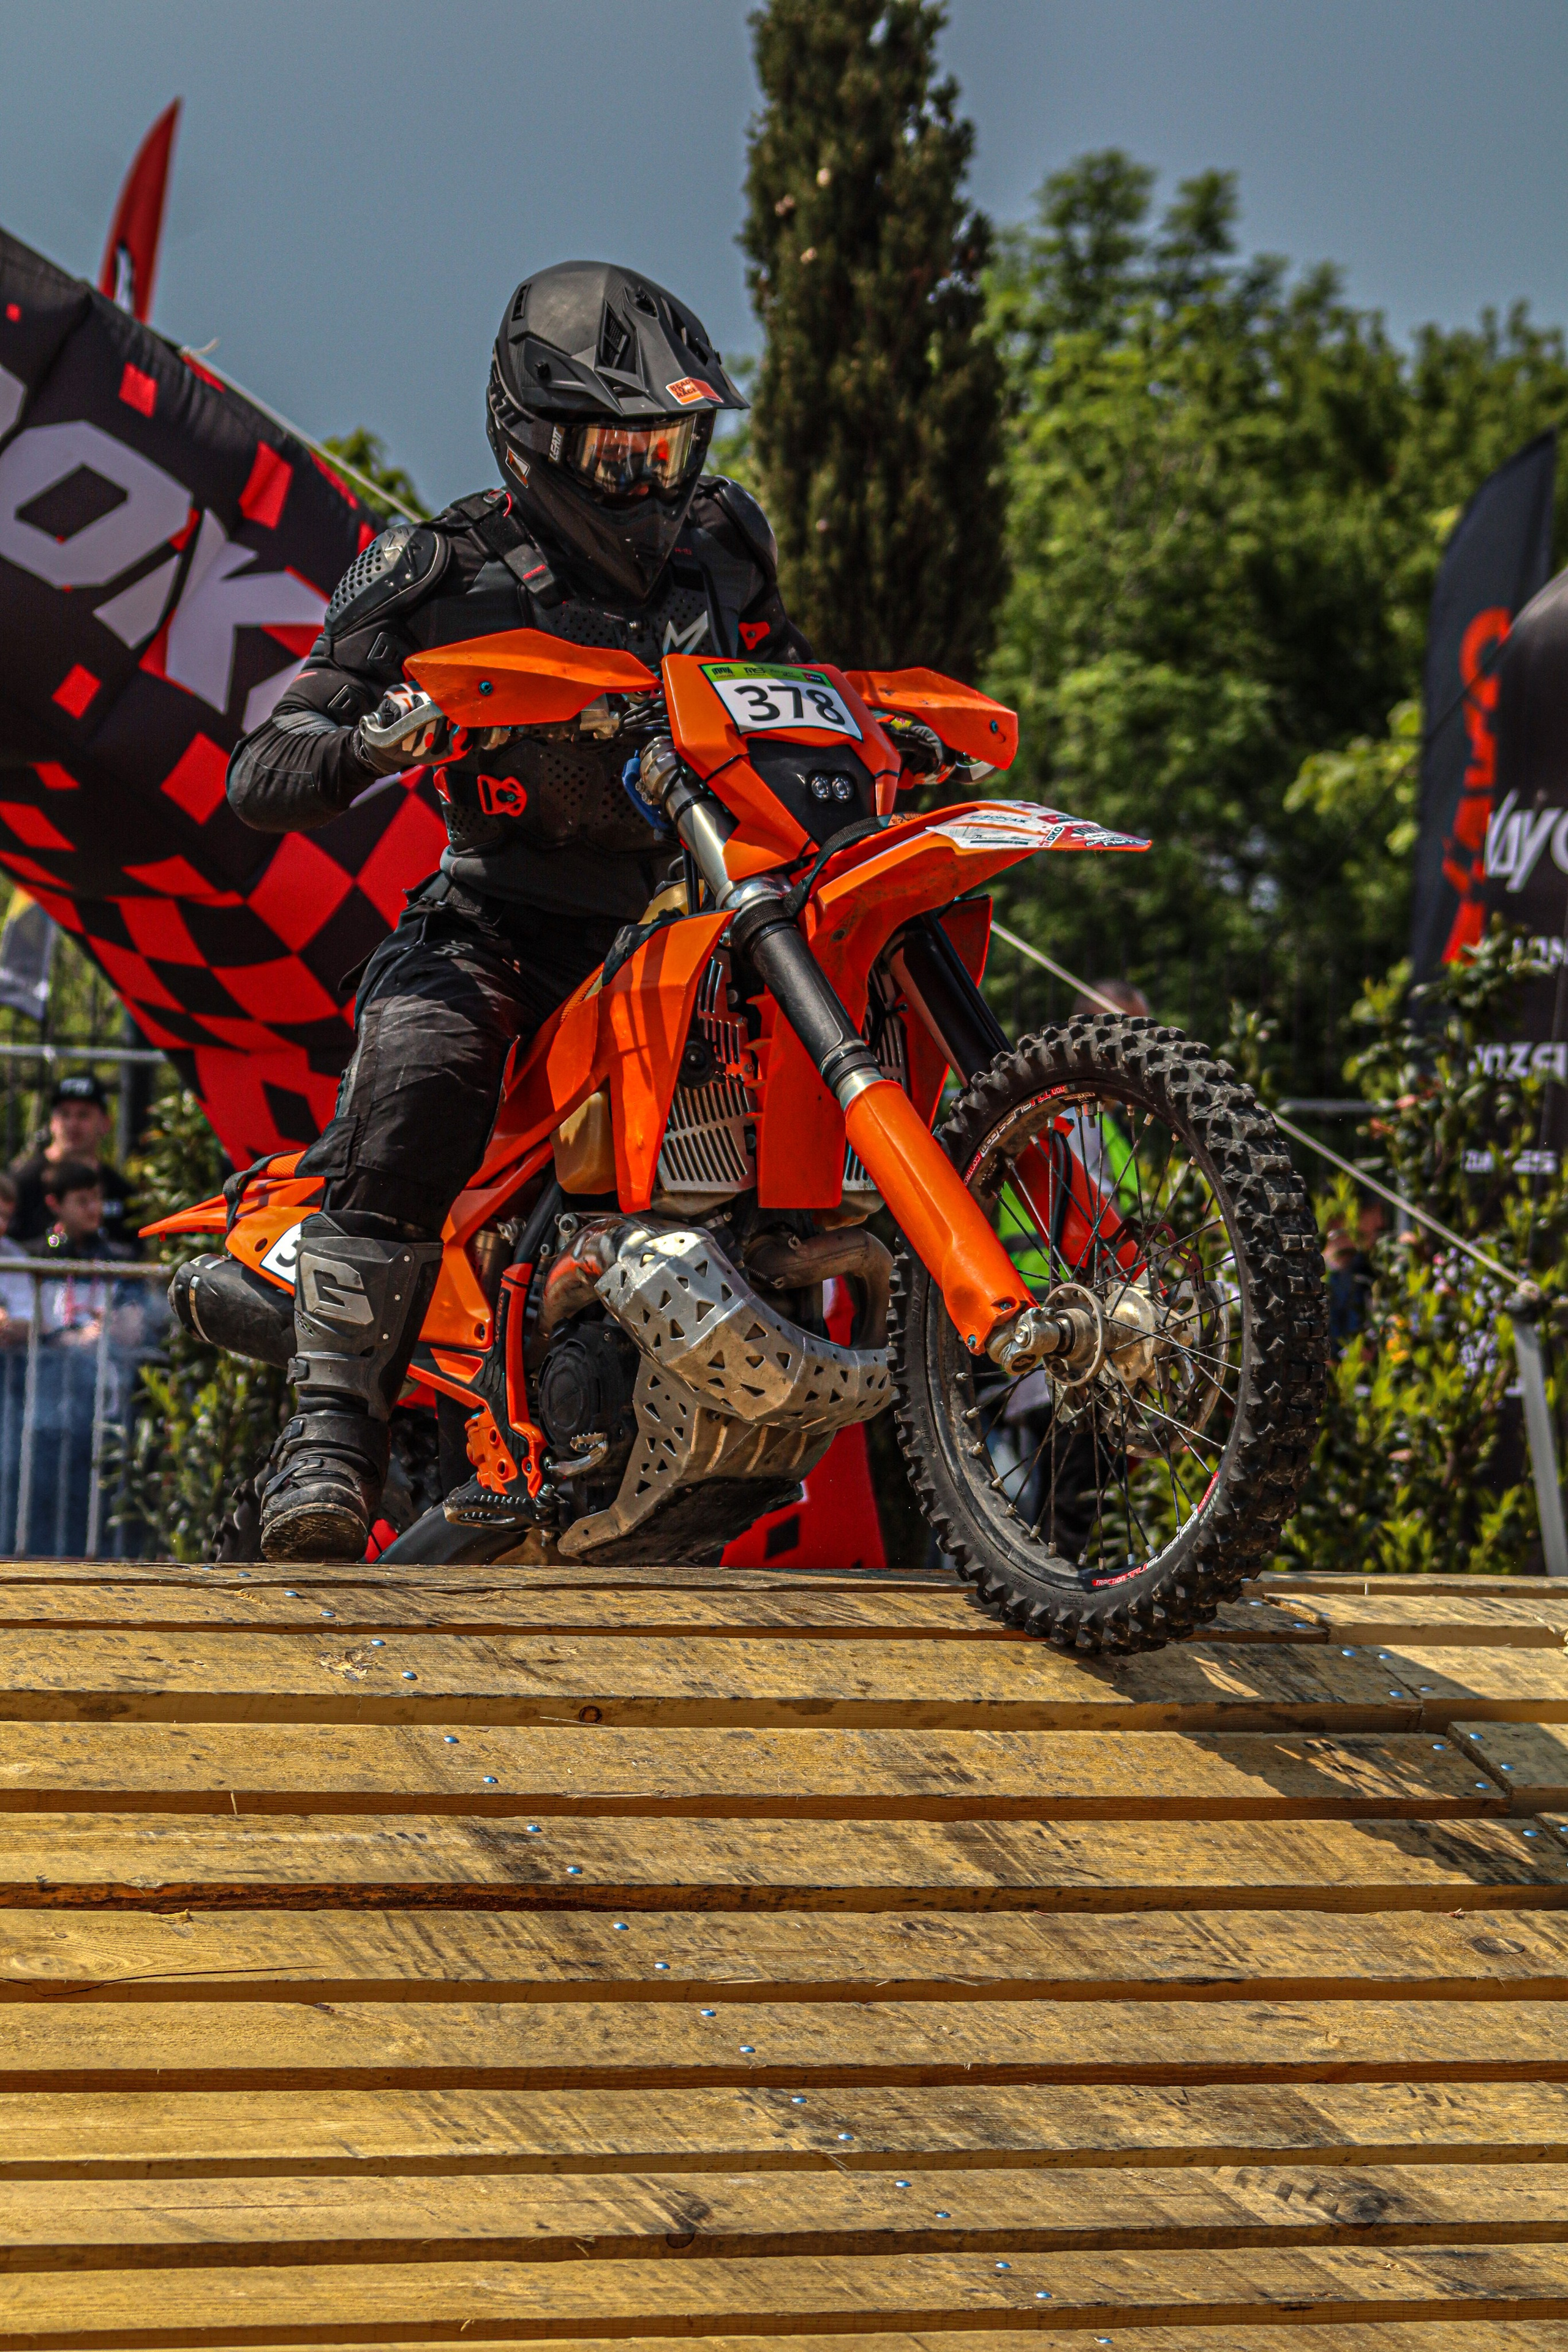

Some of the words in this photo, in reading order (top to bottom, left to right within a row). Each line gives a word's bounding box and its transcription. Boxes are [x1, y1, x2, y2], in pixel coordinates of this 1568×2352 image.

[549, 426, 564, 461] LEATT
[734, 685, 845, 725] 378
[963, 1155, 981, 1186] CONTRO
